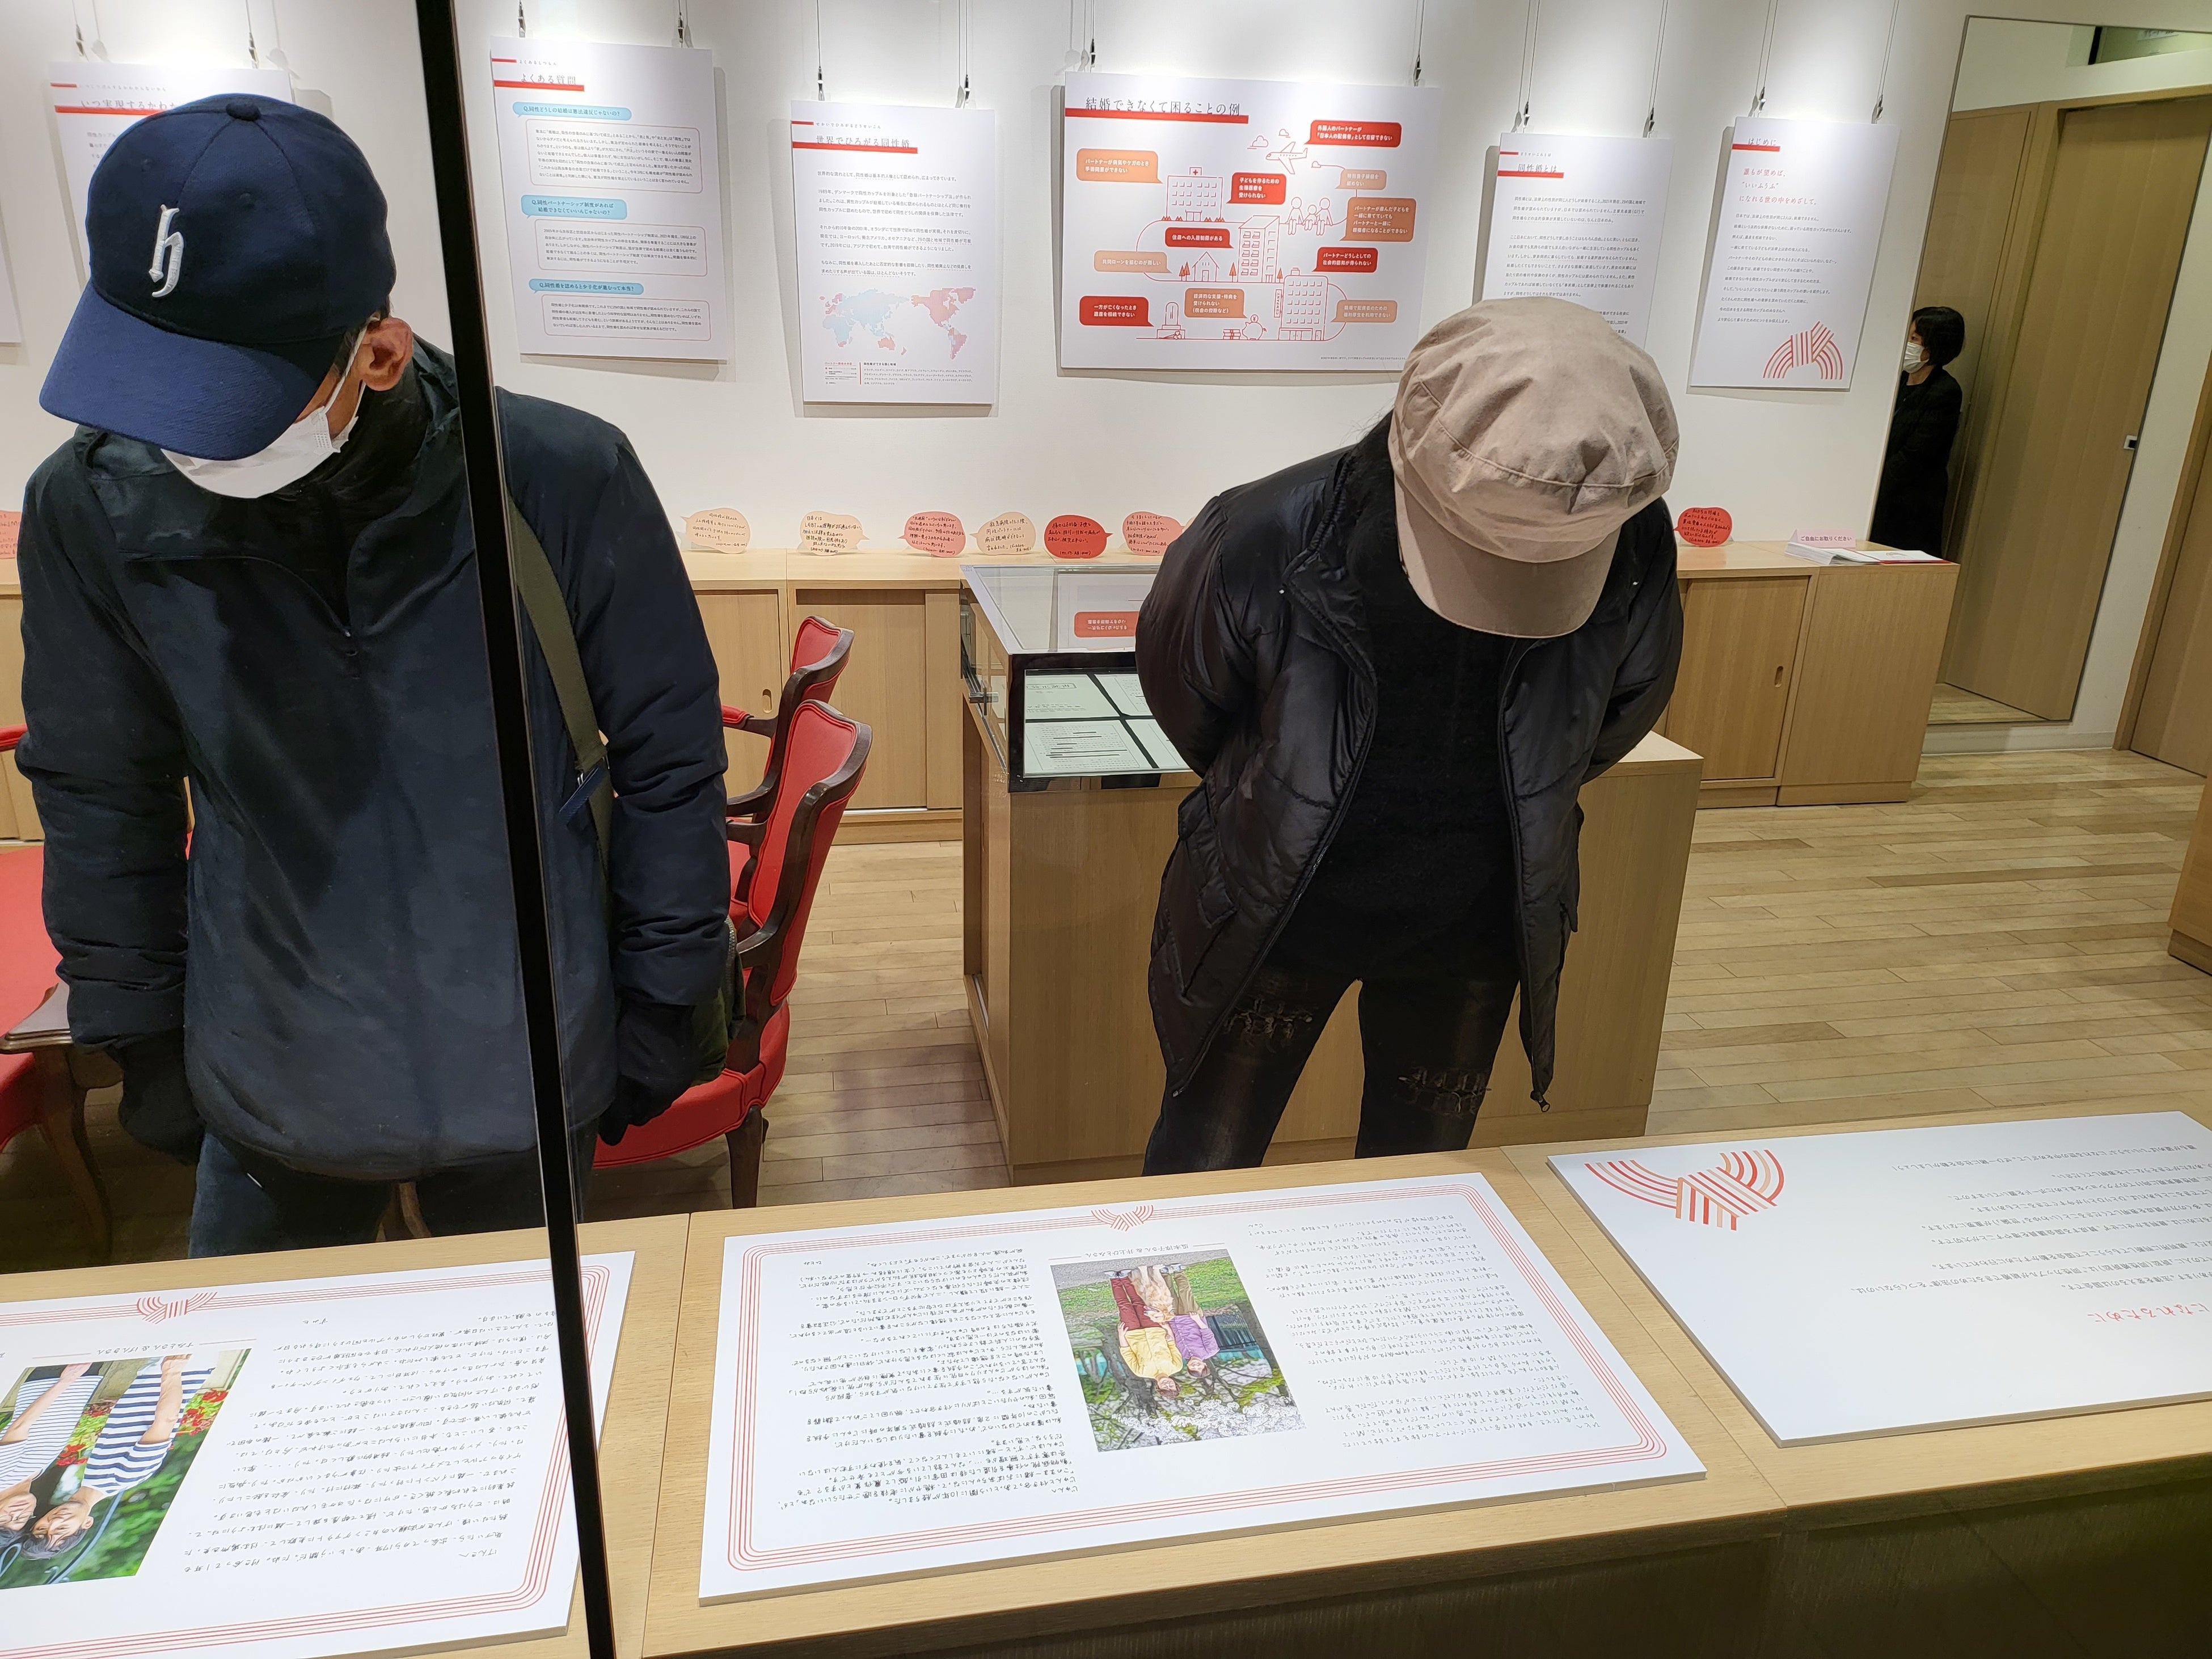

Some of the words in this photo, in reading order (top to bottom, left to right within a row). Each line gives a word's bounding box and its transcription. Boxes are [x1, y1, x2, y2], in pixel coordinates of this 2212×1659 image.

[520, 73, 576, 85] よくある質問
[816, 135, 909, 149] 世界でひろがる同性婚
[1747, 137, 1776, 146] はじめに
[1517, 163, 1556, 173] 同性婚とは
[1743, 168, 1786, 177] 誰もが望めば、
[149, 204, 184, 299] h
[1084, 1249, 1133, 1257] 井上ひとみさん
[2084, 1301, 2210, 1324] になれるために
[95, 1345, 138, 1355] げんきさん
[153, 1341, 194, 1350] すみとさん
[1022, 1400, 1057, 1409] 書いたね。
[1050, 1485, 1078, 1494] じゅんへ
[458, 1547, 497, 1559] げんきへ
